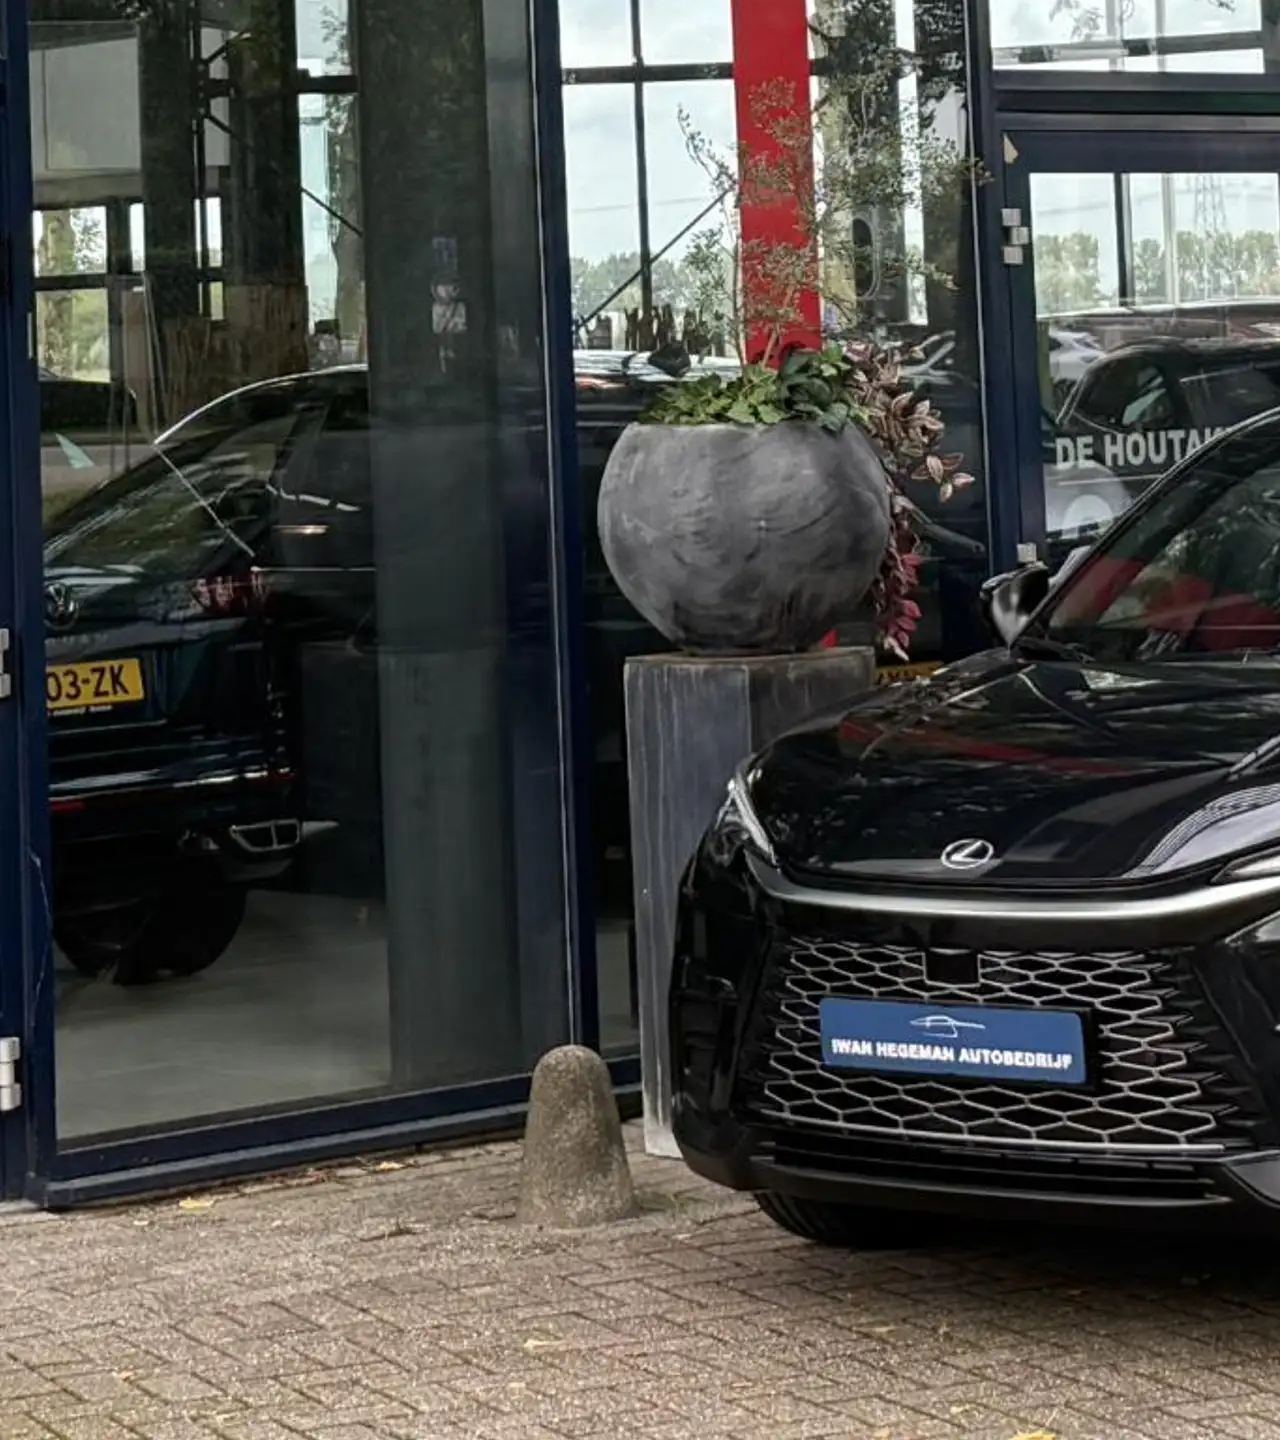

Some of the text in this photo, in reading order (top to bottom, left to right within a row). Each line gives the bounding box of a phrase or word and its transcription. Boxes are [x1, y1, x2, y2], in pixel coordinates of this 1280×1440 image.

[1055, 435, 1094, 469] DE
[831, 1037, 1073, 1070] IWAN HEGEMAN AUTOBEDRIJF
